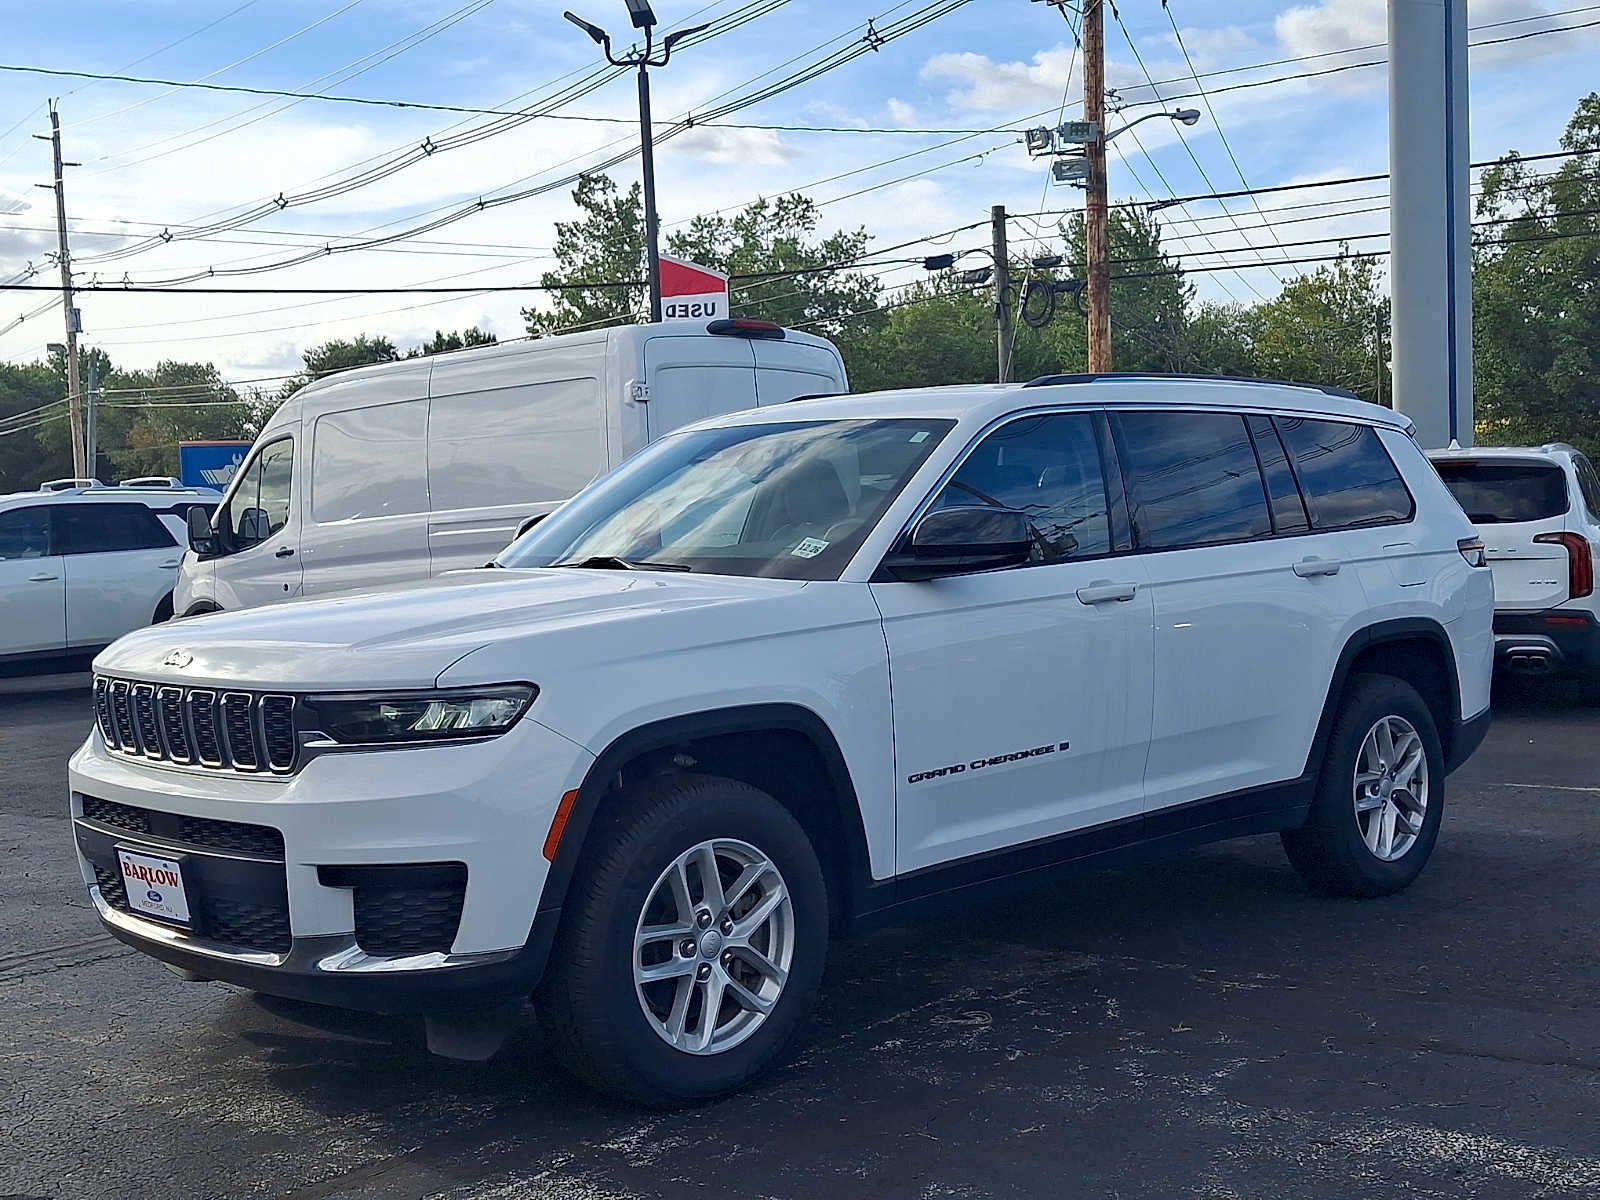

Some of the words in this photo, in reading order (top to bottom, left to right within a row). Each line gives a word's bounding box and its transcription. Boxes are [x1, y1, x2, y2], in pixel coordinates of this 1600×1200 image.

[908, 764, 966, 784] GRAND
[969, 744, 1055, 770] CHEROKEE
[123, 861, 178, 889] BARLOW
